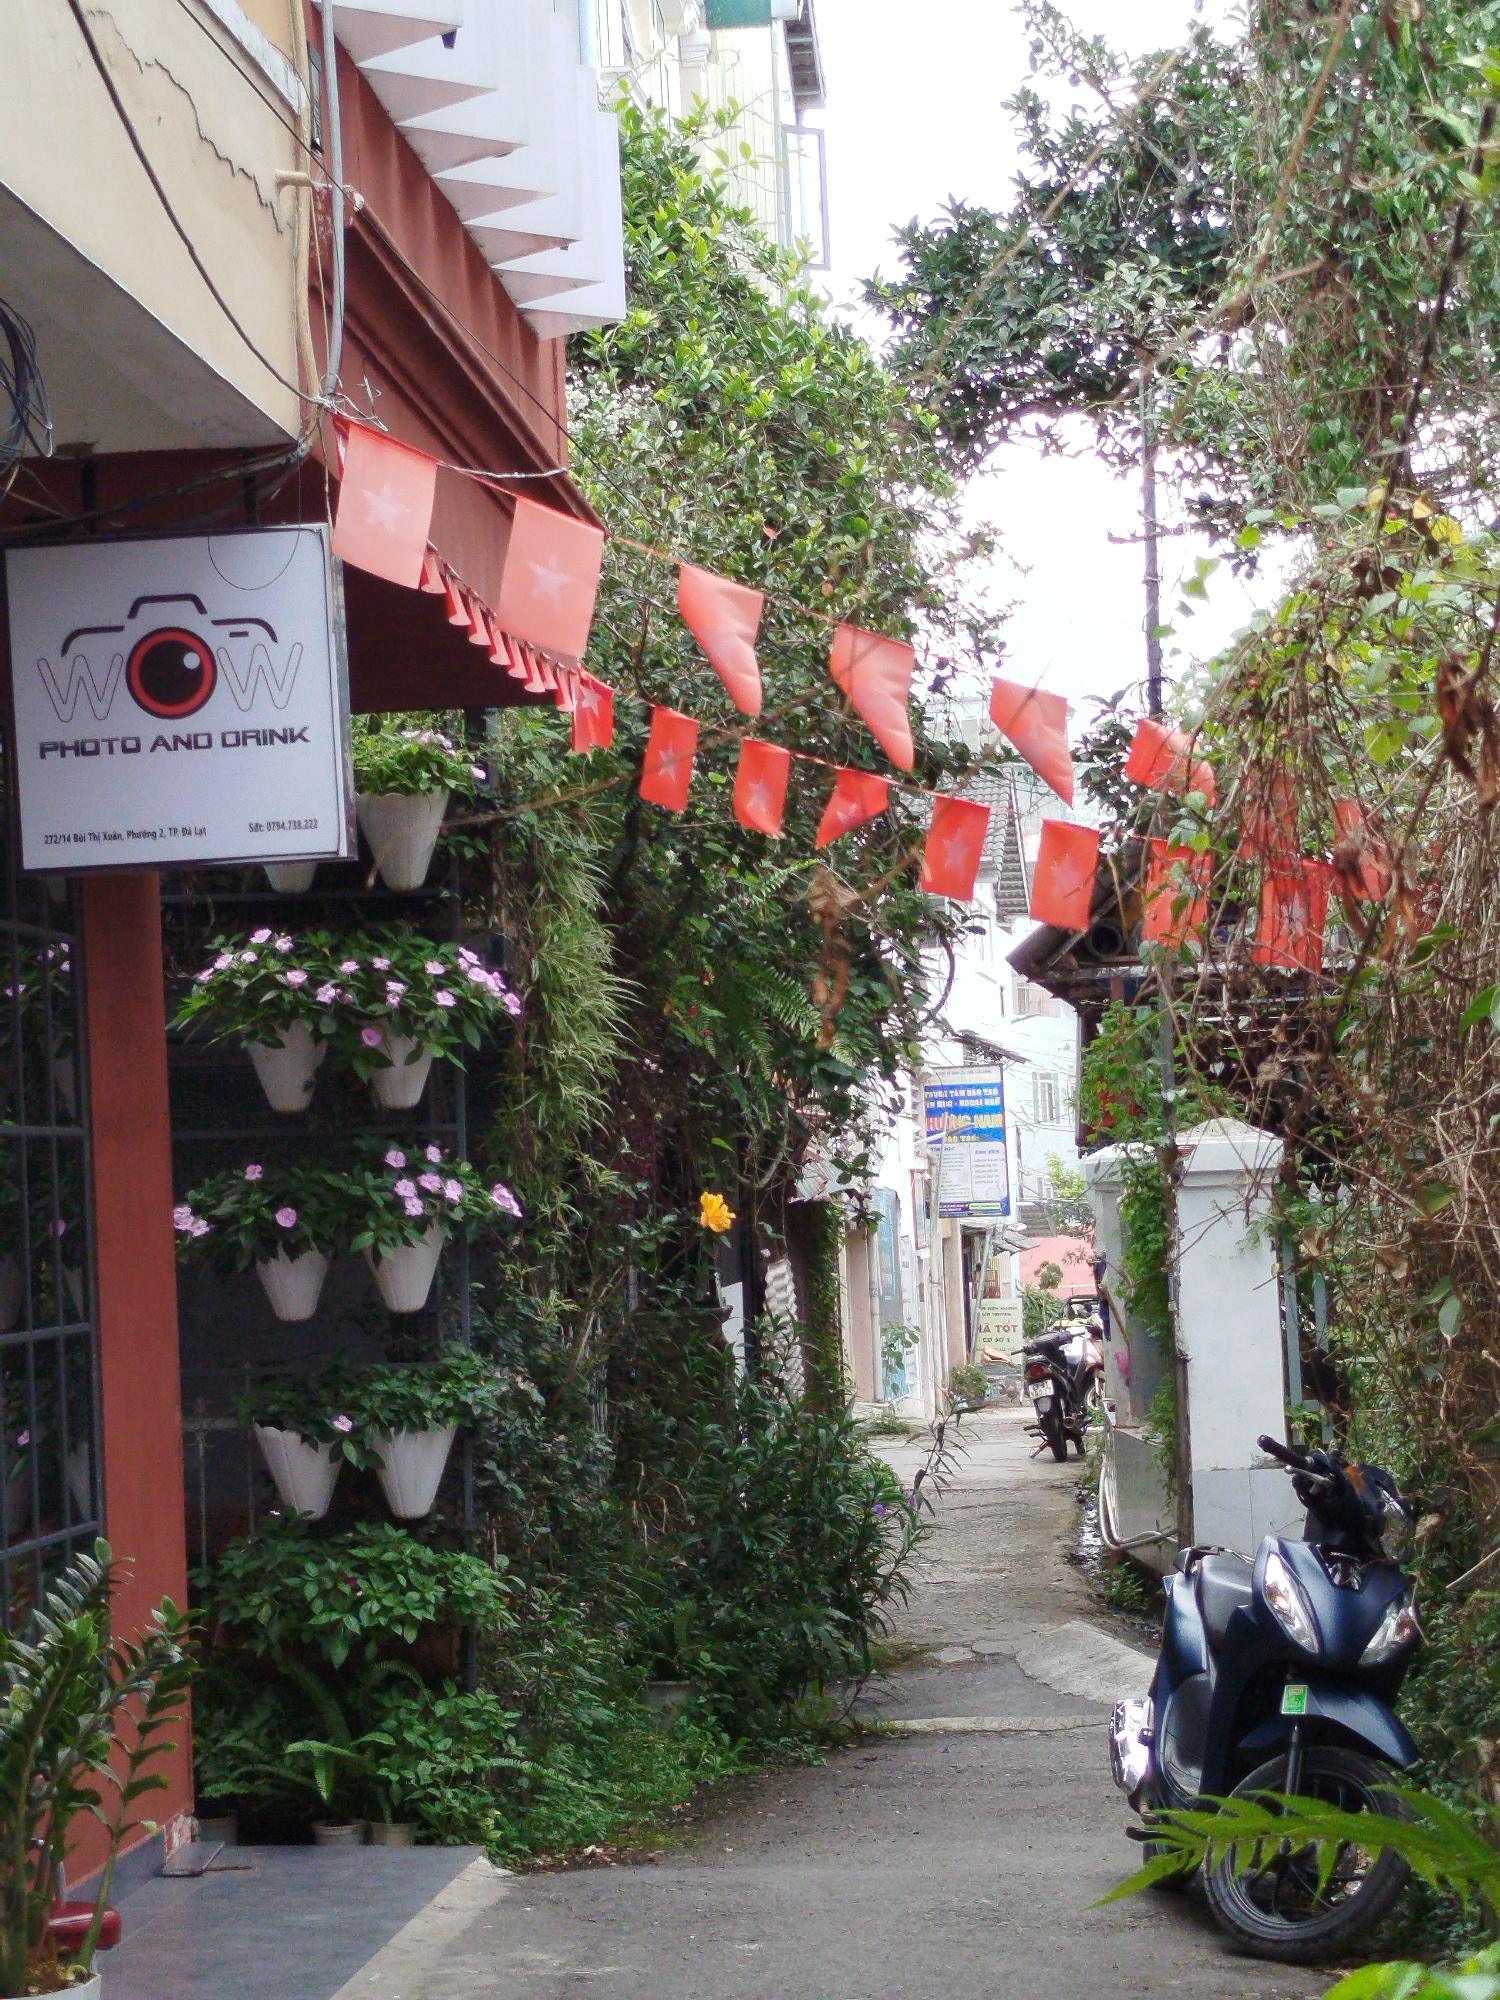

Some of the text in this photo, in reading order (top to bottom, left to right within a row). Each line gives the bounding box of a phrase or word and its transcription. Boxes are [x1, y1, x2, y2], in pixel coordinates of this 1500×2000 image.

[39, 726, 311, 759] PHOTO AND DRINK
[88, 831, 101, 844] Thị
[194, 825, 207, 837] Lạt
